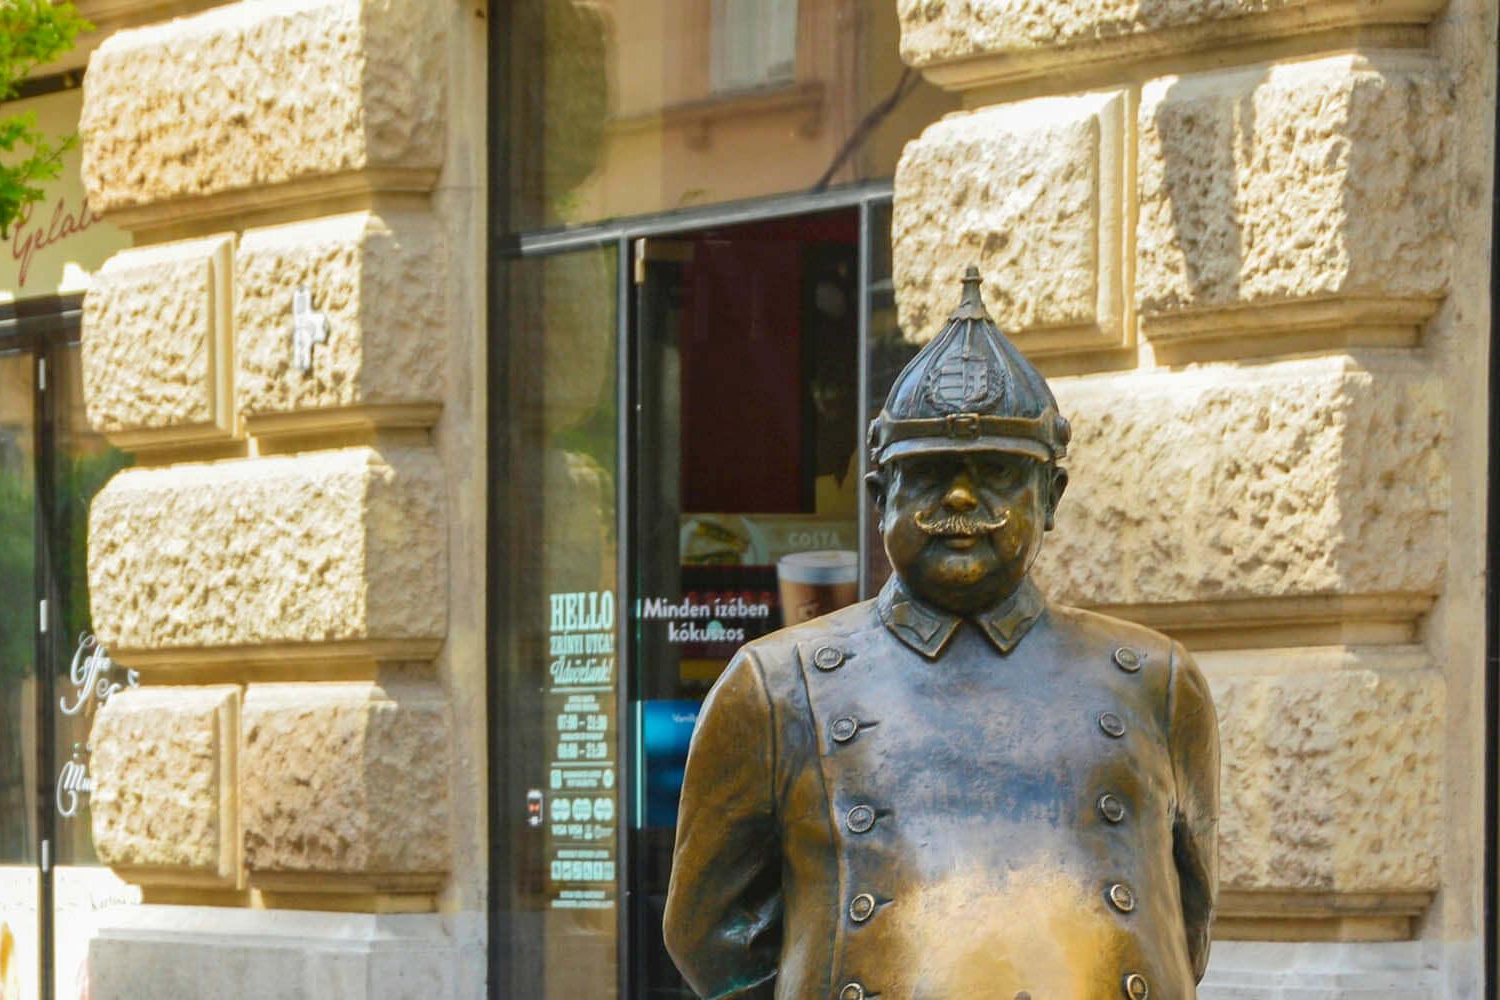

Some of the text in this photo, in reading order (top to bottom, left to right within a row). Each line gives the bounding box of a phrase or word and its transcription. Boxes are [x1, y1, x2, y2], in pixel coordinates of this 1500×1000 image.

[788, 529, 841, 549] COSTA
[549, 590, 614, 632] HELLO
[643, 598, 769, 618] Minden ízében
[668, 621, 745, 642] kókuszos
